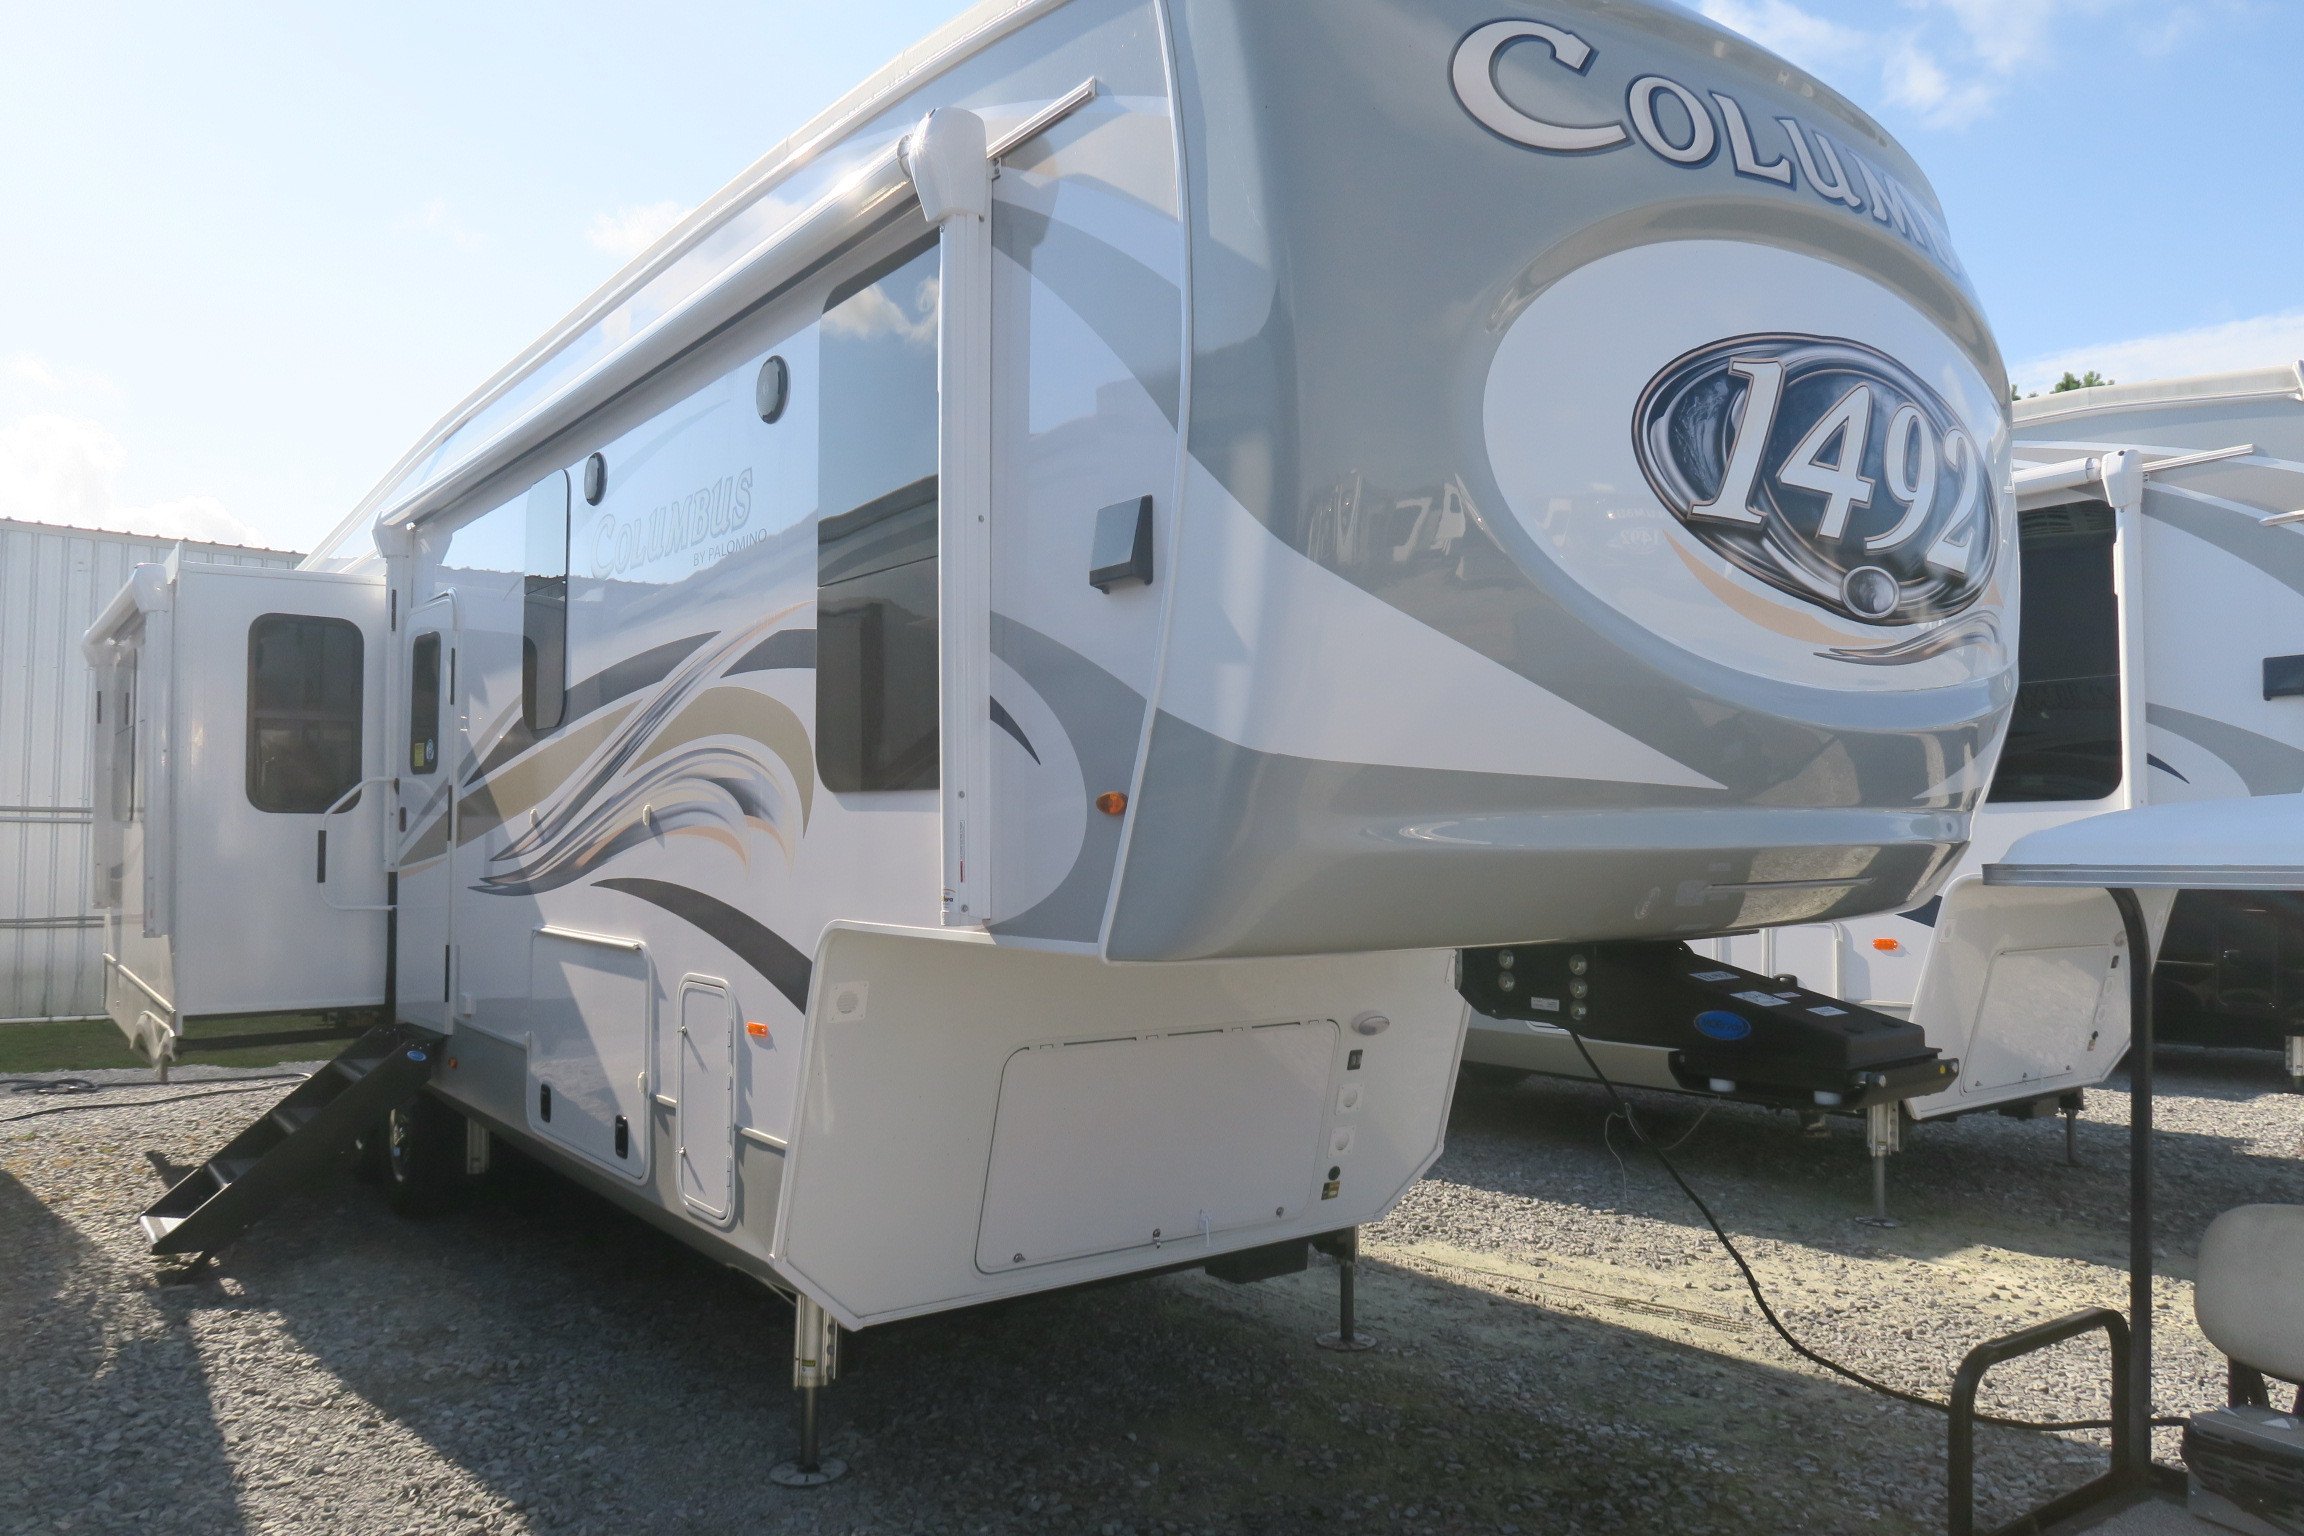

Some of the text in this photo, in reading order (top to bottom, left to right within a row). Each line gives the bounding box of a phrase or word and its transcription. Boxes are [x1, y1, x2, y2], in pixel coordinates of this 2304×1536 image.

[1447, 17, 1961, 276] COLUM
[591, 466, 753, 580] COLUMBUS
[693, 528, 767, 566] BY PALOMINO
[1686, 356, 1979, 579] 1492
